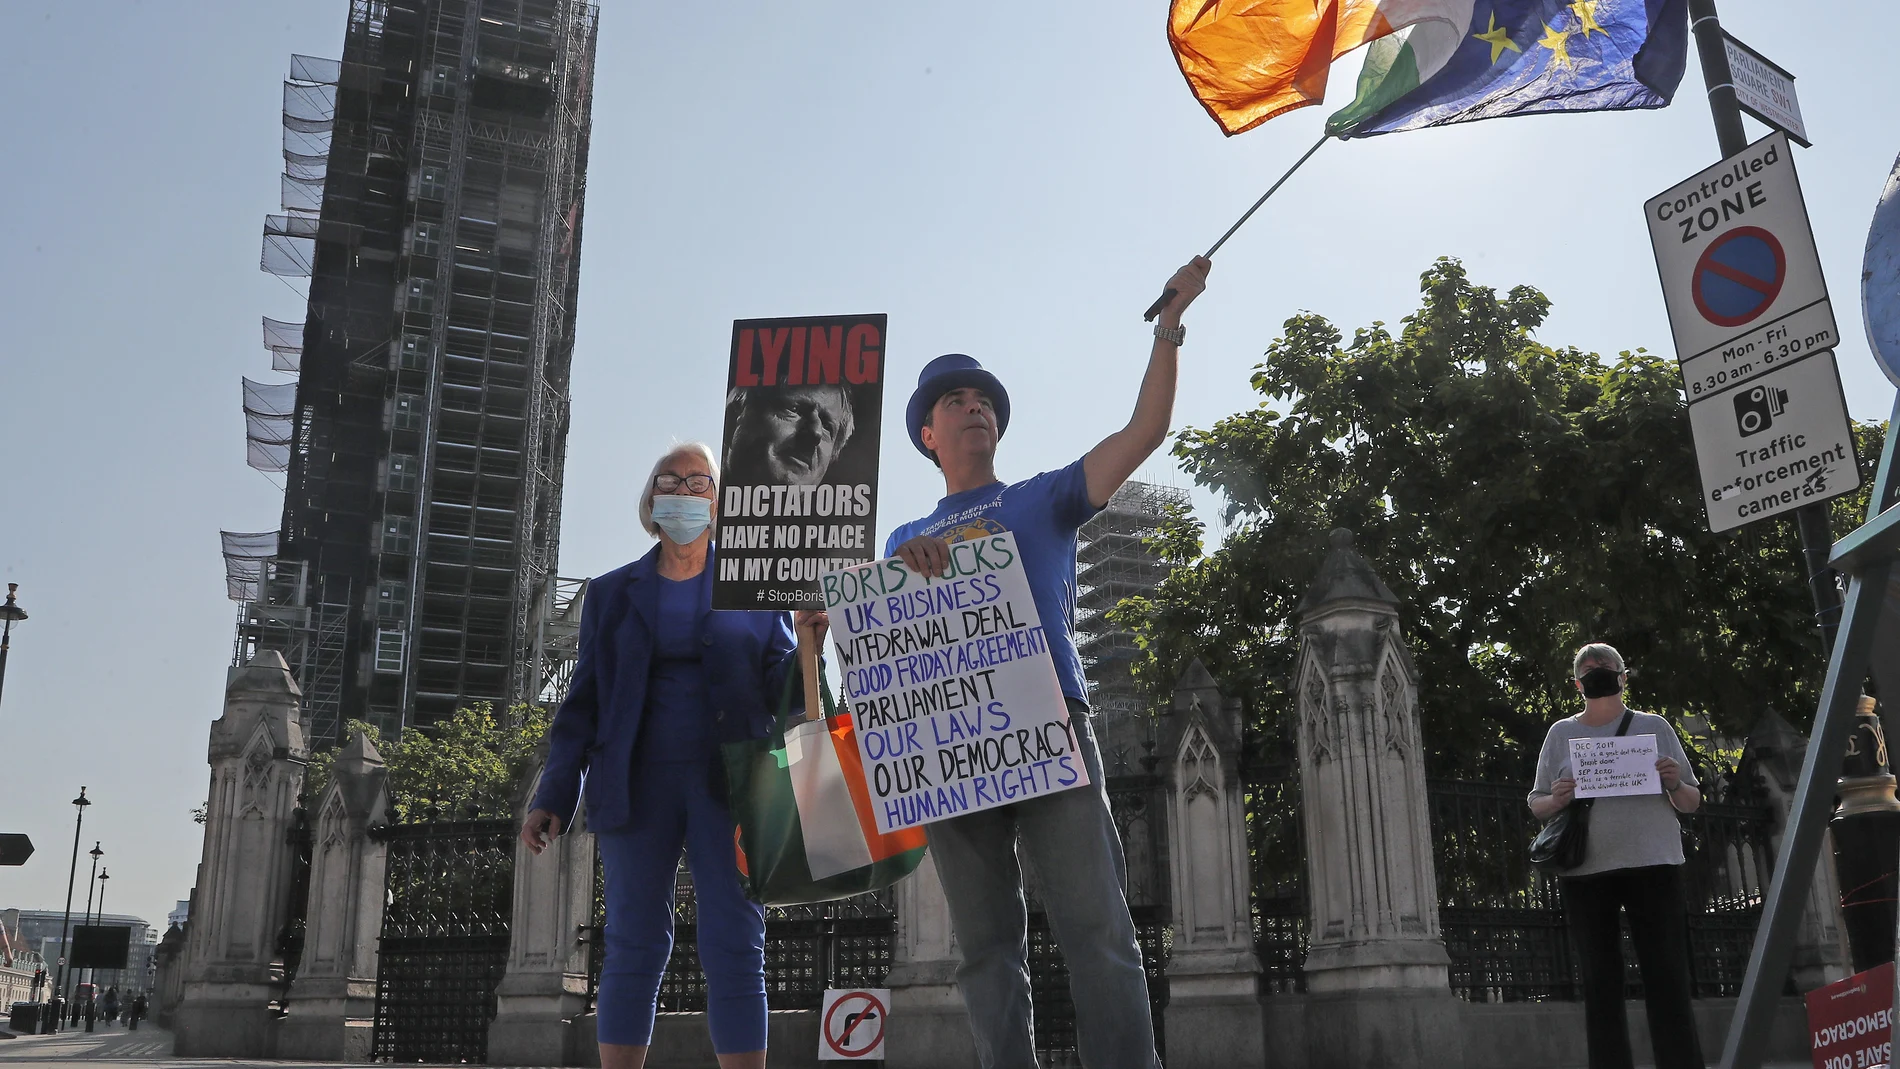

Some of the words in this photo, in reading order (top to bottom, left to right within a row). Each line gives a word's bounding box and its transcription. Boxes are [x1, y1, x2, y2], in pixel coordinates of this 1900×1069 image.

[1727, 46, 1786, 93] PARLIAMENT
[1730, 63, 1770, 98] SQUARE
[1771, 88, 1792, 112] SW1
[1735, 87, 1749, 101] CITY
[1750, 96, 1759, 106] OF
[1657, 144, 1779, 221] Controlled
[1678, 181, 1767, 244] ZONE
[735, 323, 879, 387] LYING
[1692, 371, 1727, 395] 8.30
[1730, 361, 1753, 379] am
[1763, 339, 1801, 365] 6.30
[1804, 329, 1829, 350] pm
[1722, 344, 1755, 363] Mon
[1766, 325, 1787, 344] Fri
[1735, 434, 1806, 467] Traffic
[723, 484, 871, 517] DICTATORS
[948, 512, 960, 520] OF
[1737, 479, 1827, 518] cameras
[721, 525, 769, 549] HAVE
[774, 525, 801, 549] NO
[804, 525, 865, 549] PLACE
[719, 558, 741, 581] IN
[743, 558, 773, 581] MY
[823, 559, 908, 608] BORIS
[925, 537, 1014, 586] UCKS
[1834, 576, 1843, 590] 2
[844, 601, 883, 634] UK
[888, 574, 1001, 625] BUSINESS
[962, 601, 1027, 639] DEAL
[847, 663, 892, 698] GOOD
[895, 645, 956, 688] FRIDAY
[956, 626, 1047, 675] AGREEMENT
[855, 669, 996, 731] PARLIAMENT
[864, 722, 923, 761] OUR
[931, 701, 1011, 746] LAWS
[874, 755, 932, 798] OUR
[938, 716, 1076, 784] DEMOCRACY
[1610, 772, 1631, 780] terrible
[884, 782, 968, 829] HUMAN
[973, 756, 1079, 807] RIGHTS
[1856, 1042, 1891, 1068] SAVE
